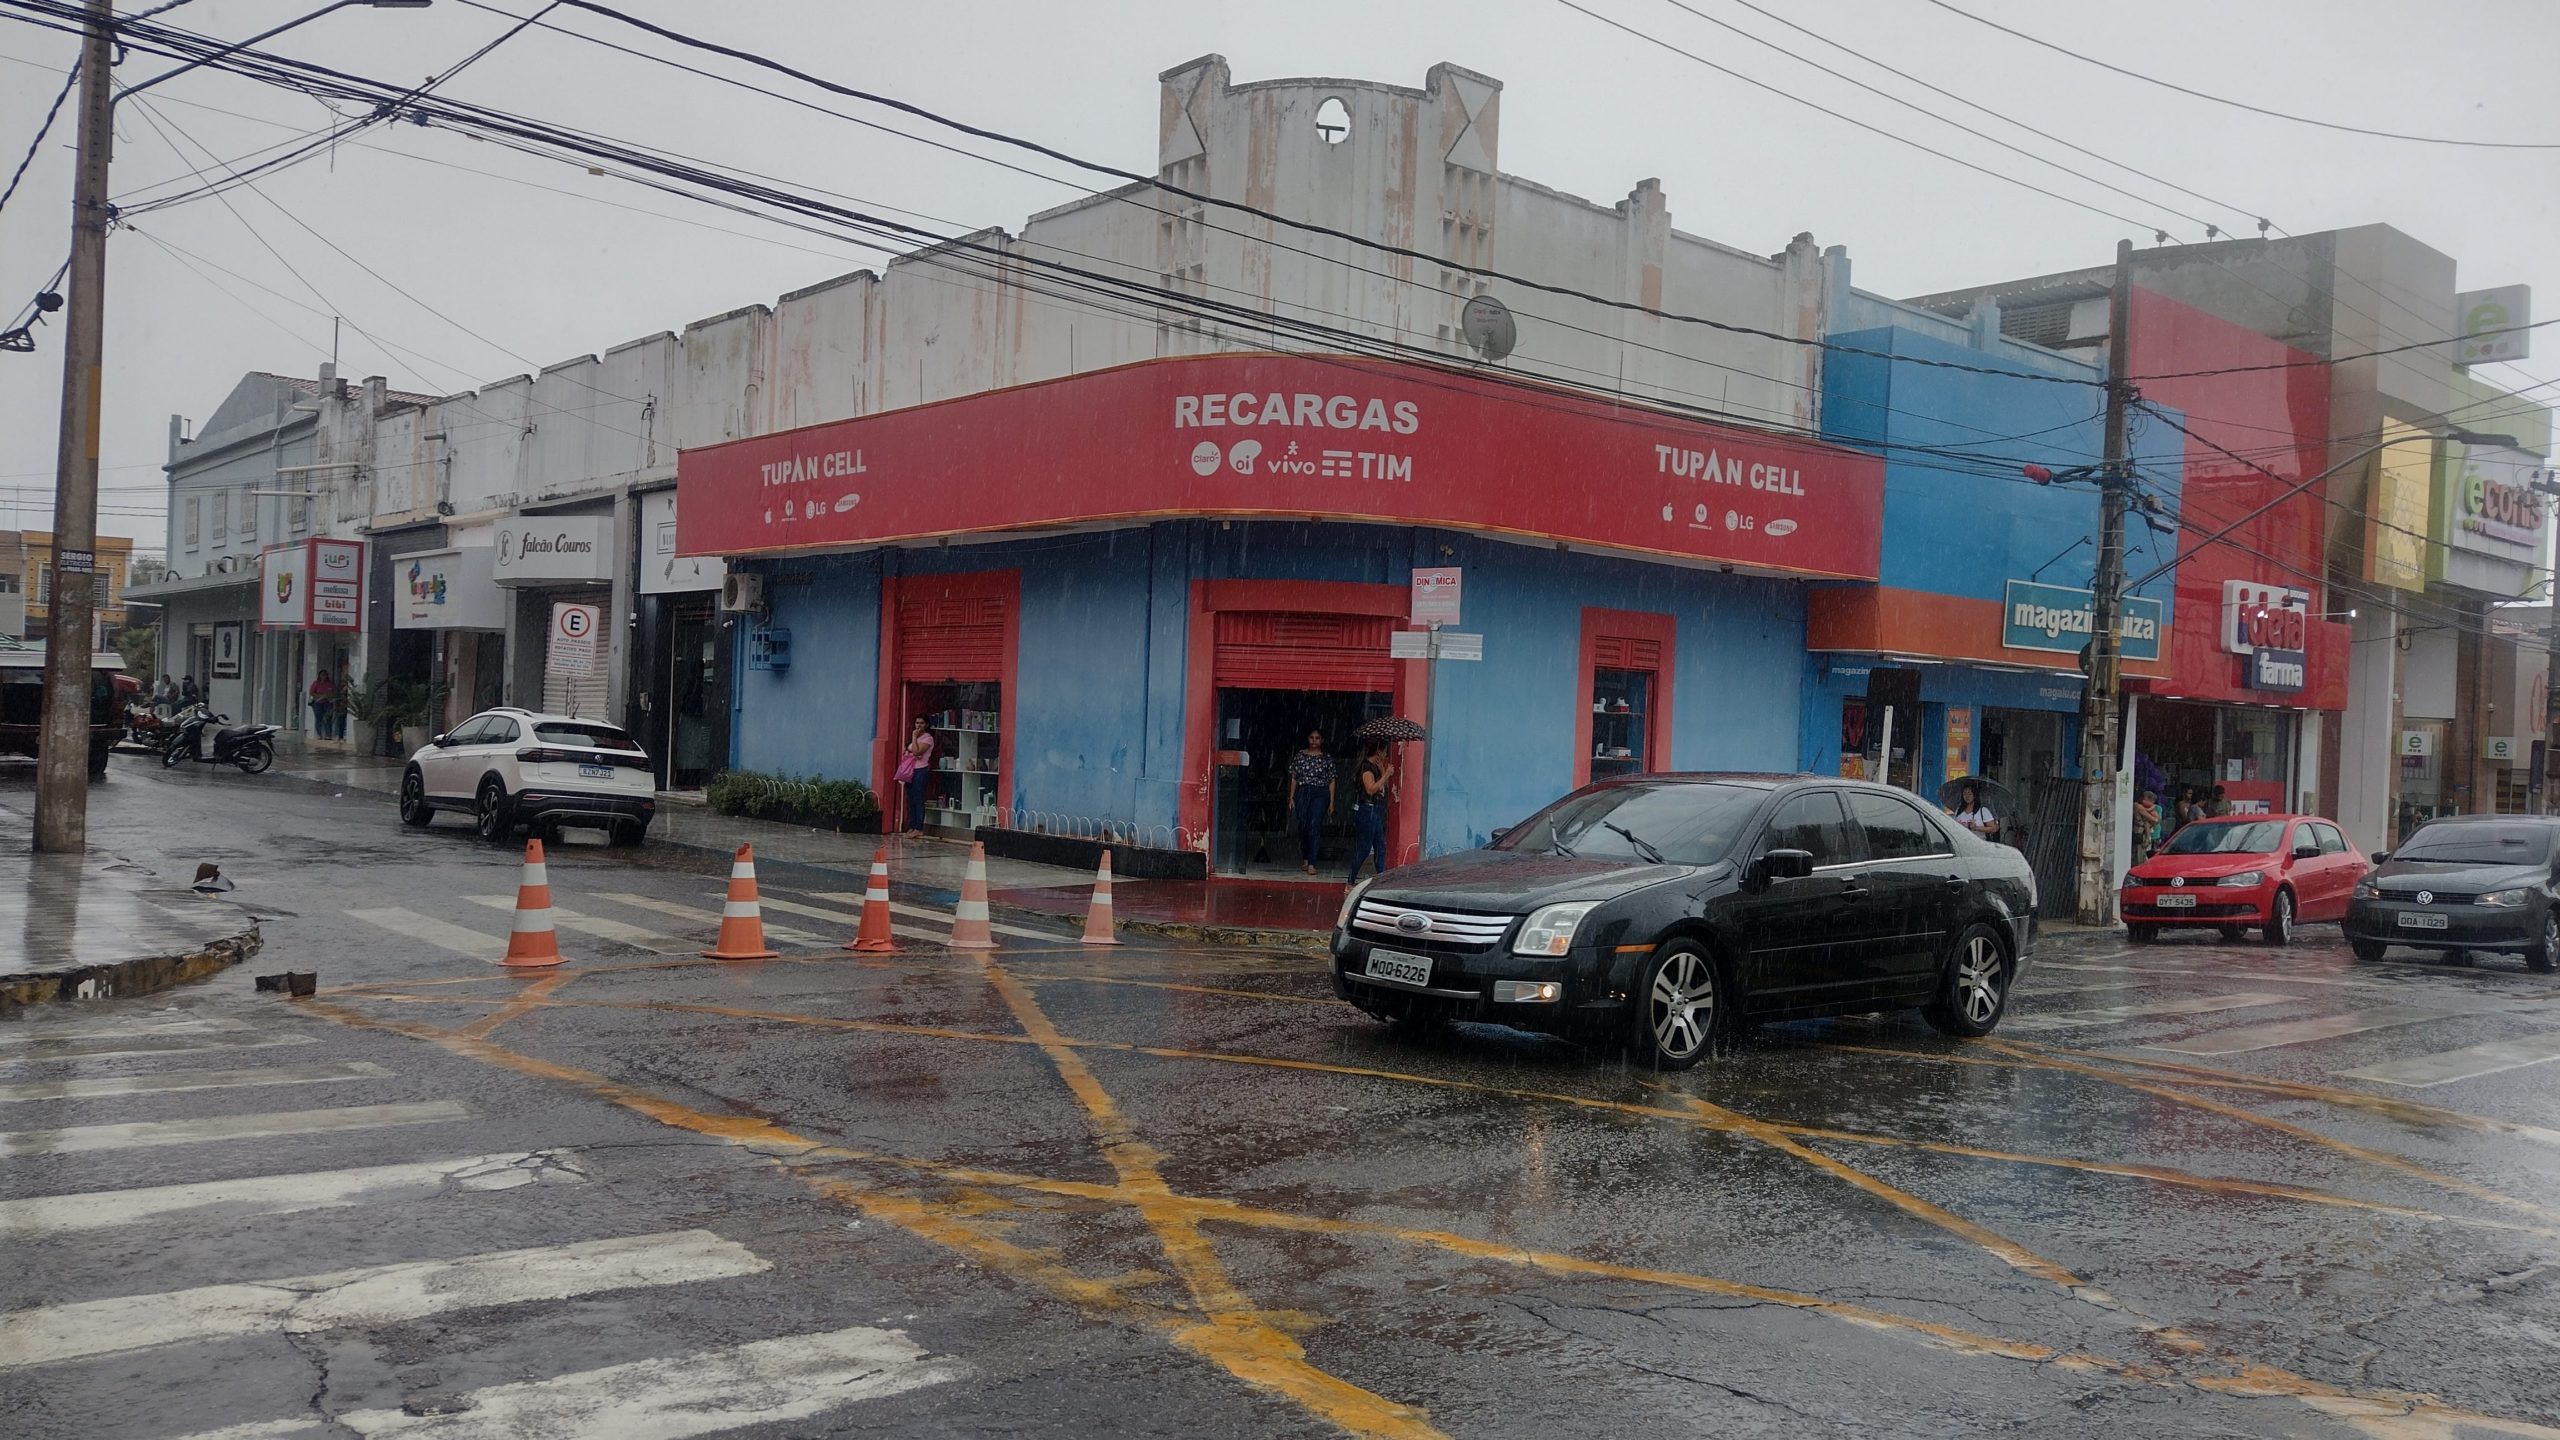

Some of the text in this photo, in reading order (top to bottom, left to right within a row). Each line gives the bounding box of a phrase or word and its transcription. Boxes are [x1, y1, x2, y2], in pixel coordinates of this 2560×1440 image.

[1174, 393, 1420, 434] RECARGAS
[1193, 452, 1215, 464] Claro
[1236, 455, 1250, 471] oi
[1267, 454, 1316, 475] vivo
[1357, 452, 1412, 482] TIM
[761, 449, 867, 487] TUPAN CELL
[1655, 444, 1805, 496] TUPAN CELL
[815, 501, 826, 515] LG
[1739, 514, 1754, 530] LG
[519, 532, 592, 560] falcão Couros
[325, 599, 346, 609] bibi
[570, 615, 582, 631] E
[2014, 603, 2155, 640] magazi uiza
[1831, 666, 1872, 676] magazin
[2259, 652, 2304, 687] farma
[2039, 687, 2082, 700] magalu.co
